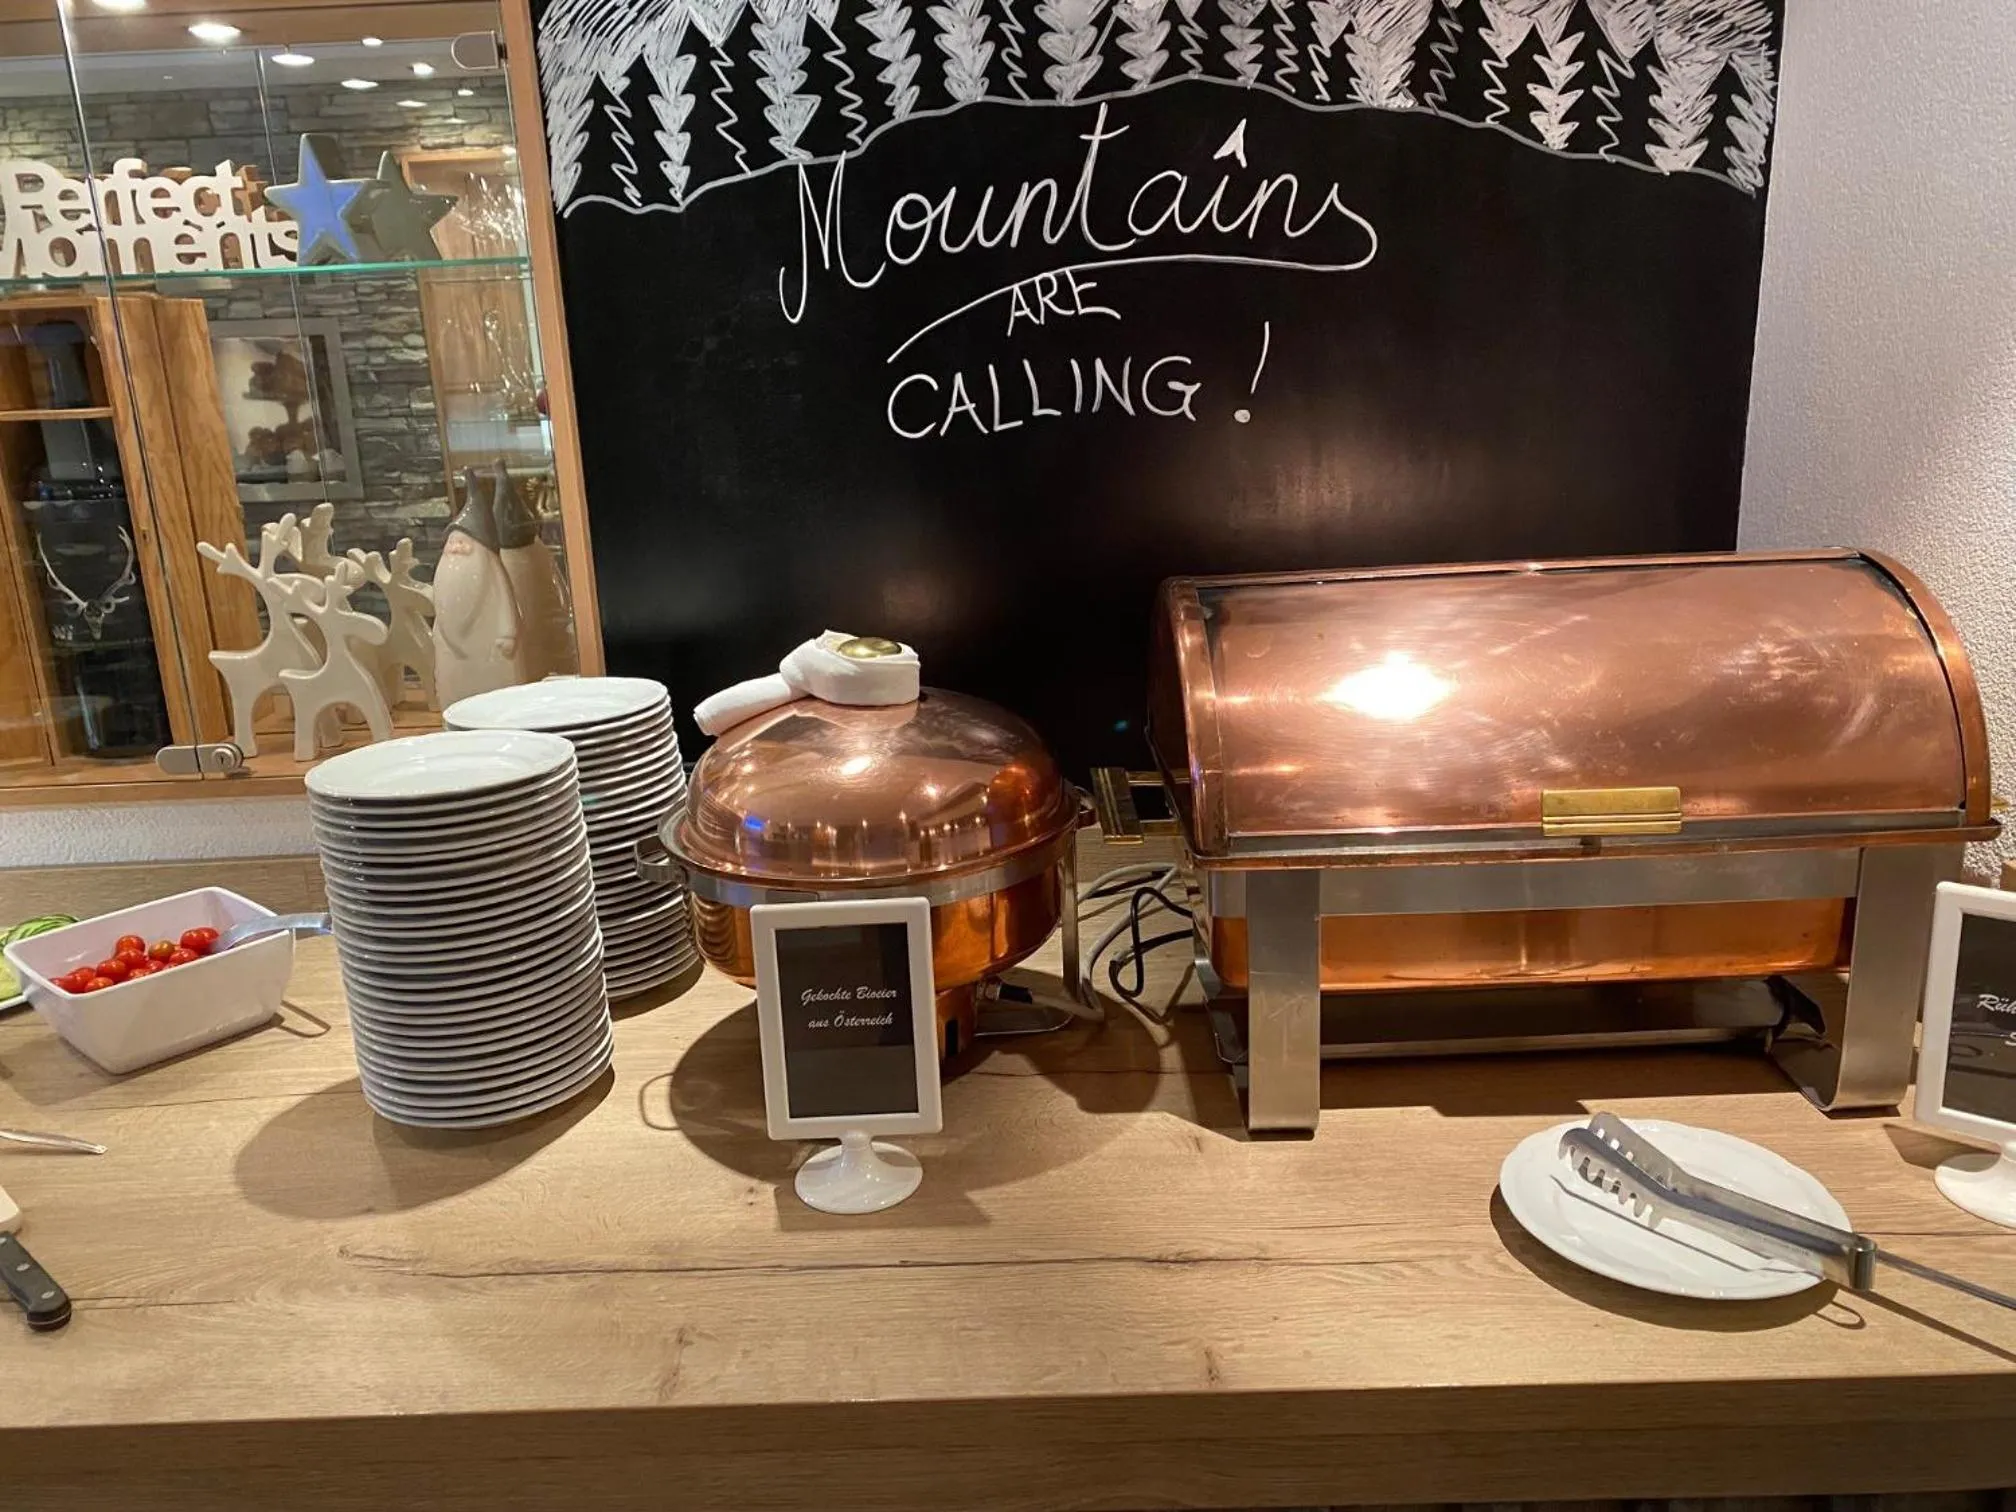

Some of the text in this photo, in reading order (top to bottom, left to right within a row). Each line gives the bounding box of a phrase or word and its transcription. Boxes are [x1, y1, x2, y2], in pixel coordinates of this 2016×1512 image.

[0, 158, 244, 226] Perfect
[779, 102, 1378, 323] Mountains
[1007, 267, 1122, 337] ARE
[887, 355, 1202, 439] CALLING
[801, 985, 897, 1006] Gekochte Bioeier
[808, 1010, 893, 1028] aus Österreich
